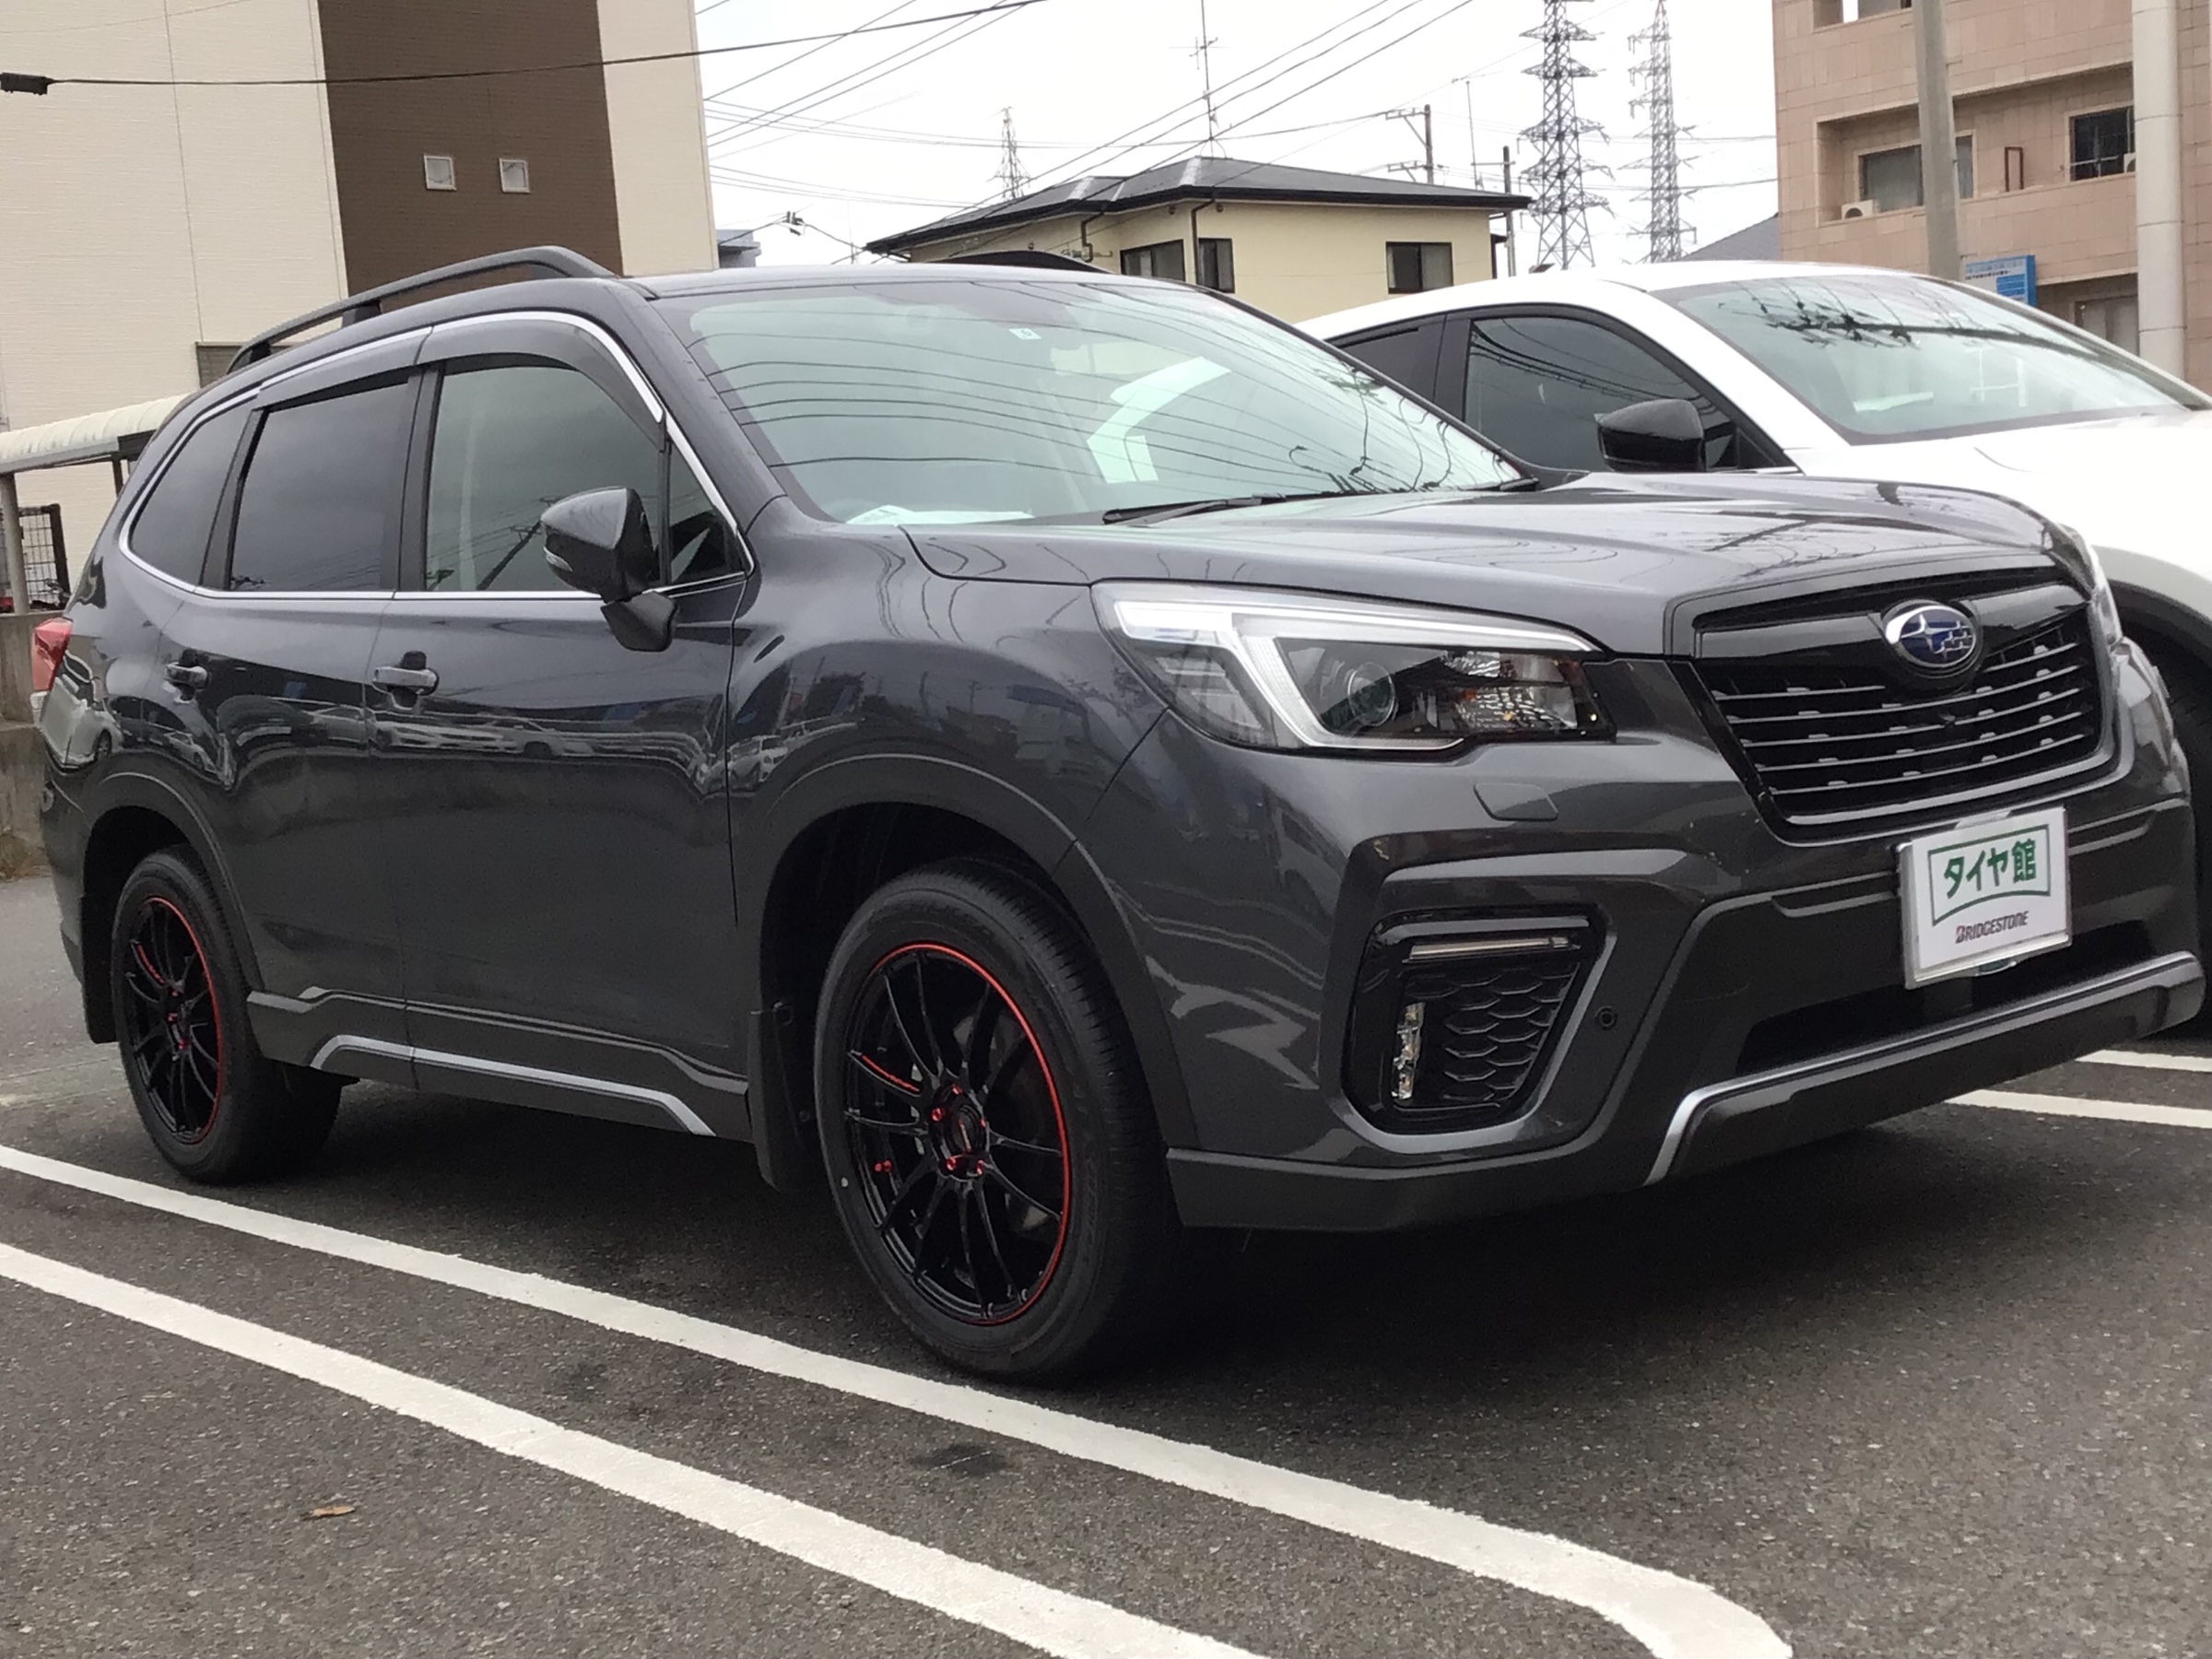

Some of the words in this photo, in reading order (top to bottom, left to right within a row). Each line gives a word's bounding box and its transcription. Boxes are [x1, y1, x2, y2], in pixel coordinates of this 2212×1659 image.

[1944, 838, 2036, 899] タイヤ館
[1955, 911, 2030, 944] BRIDGESTONE
